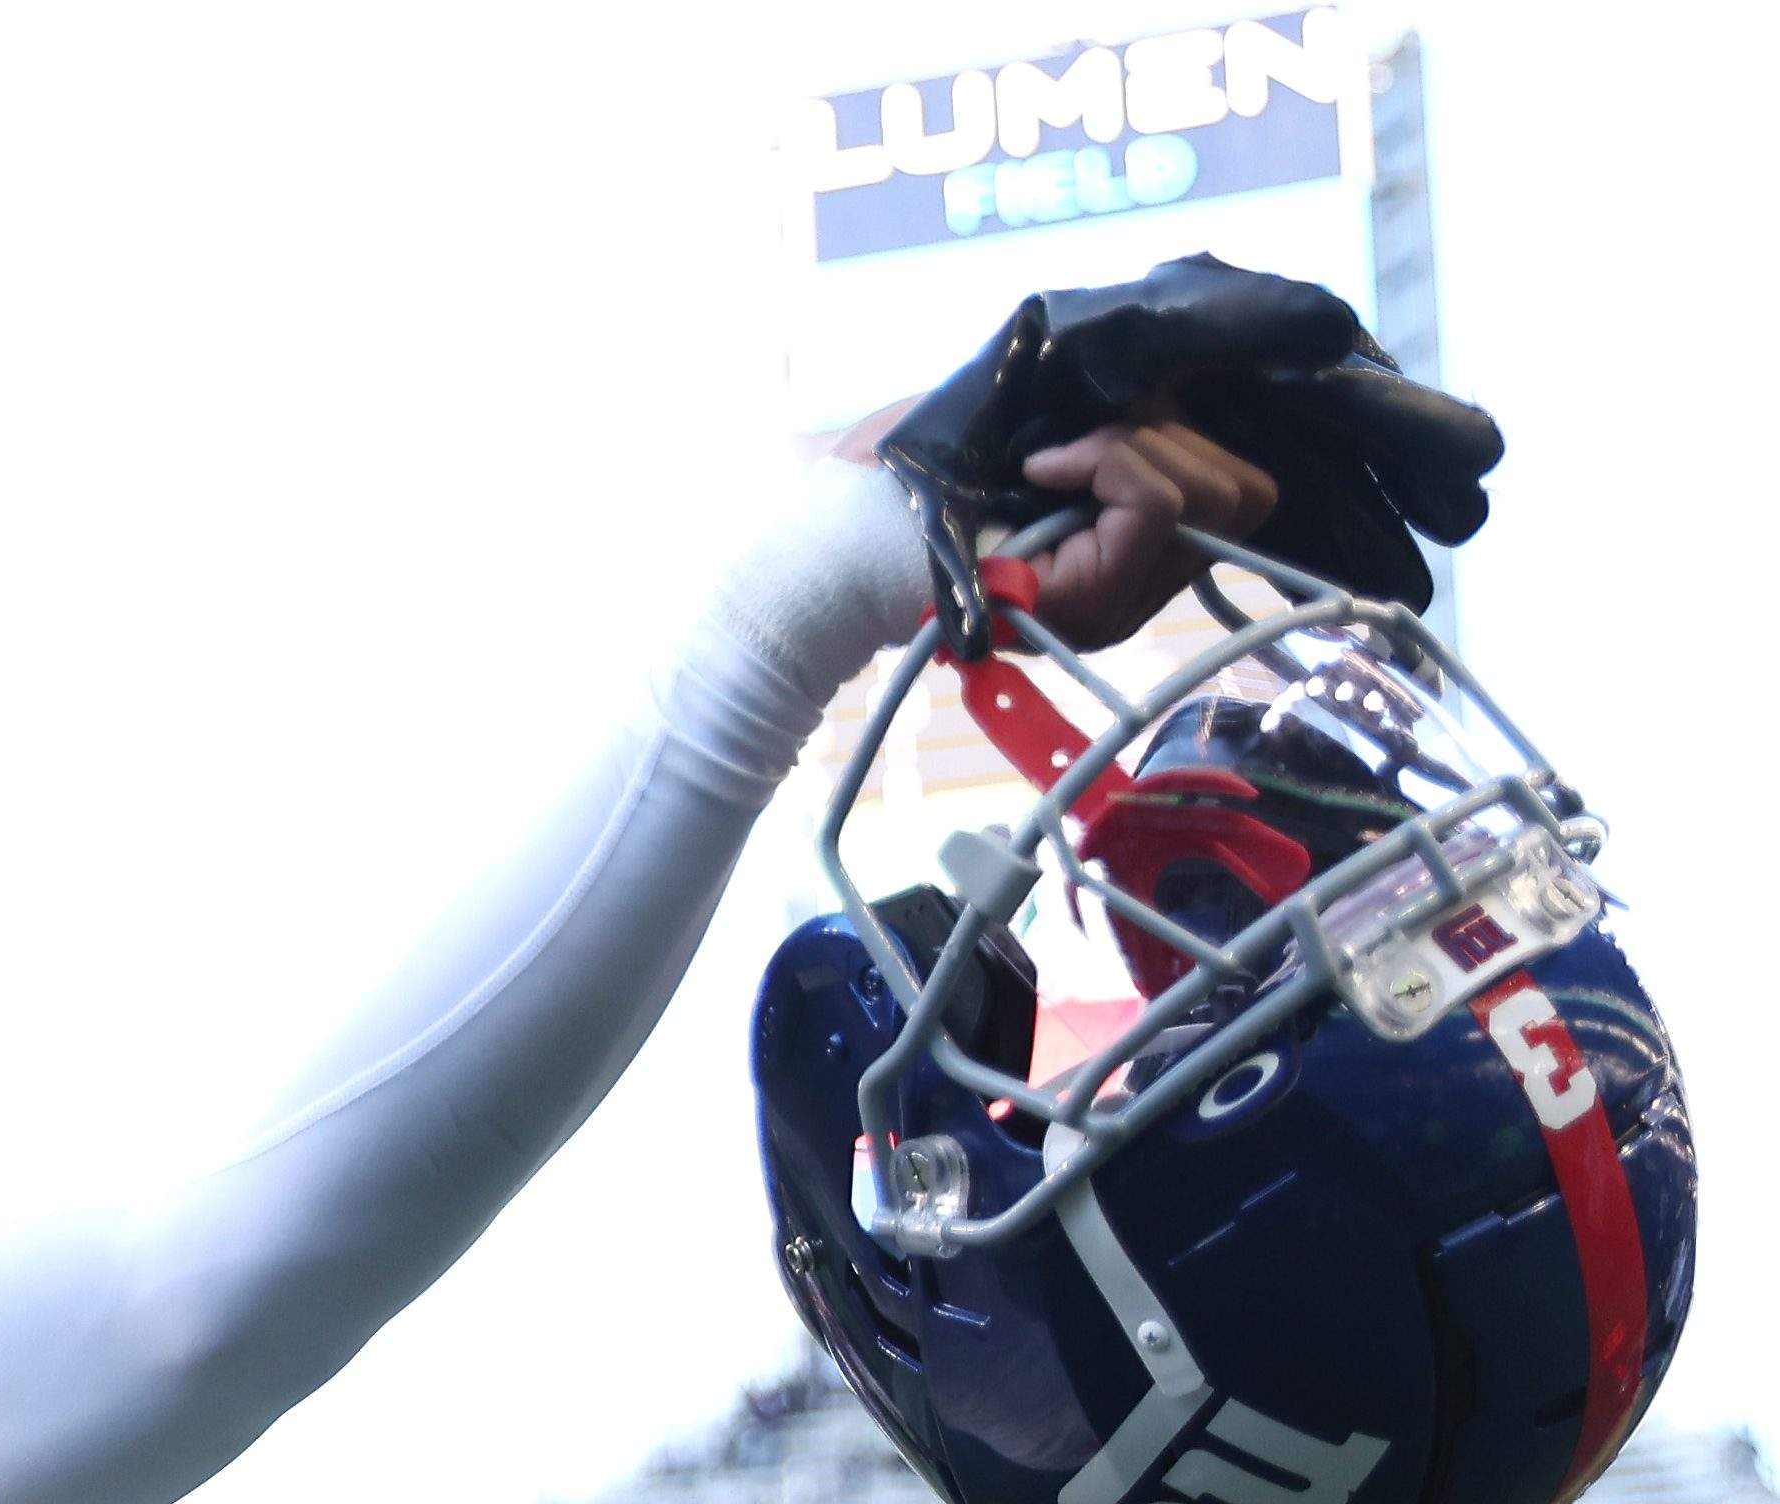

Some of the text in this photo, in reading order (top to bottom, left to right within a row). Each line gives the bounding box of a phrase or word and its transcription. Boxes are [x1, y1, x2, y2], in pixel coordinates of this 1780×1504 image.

[807, 6, 1339, 194] LUMEN
[942, 132, 1198, 237] FIELD
[1487, 985, 1598, 1131] 3
